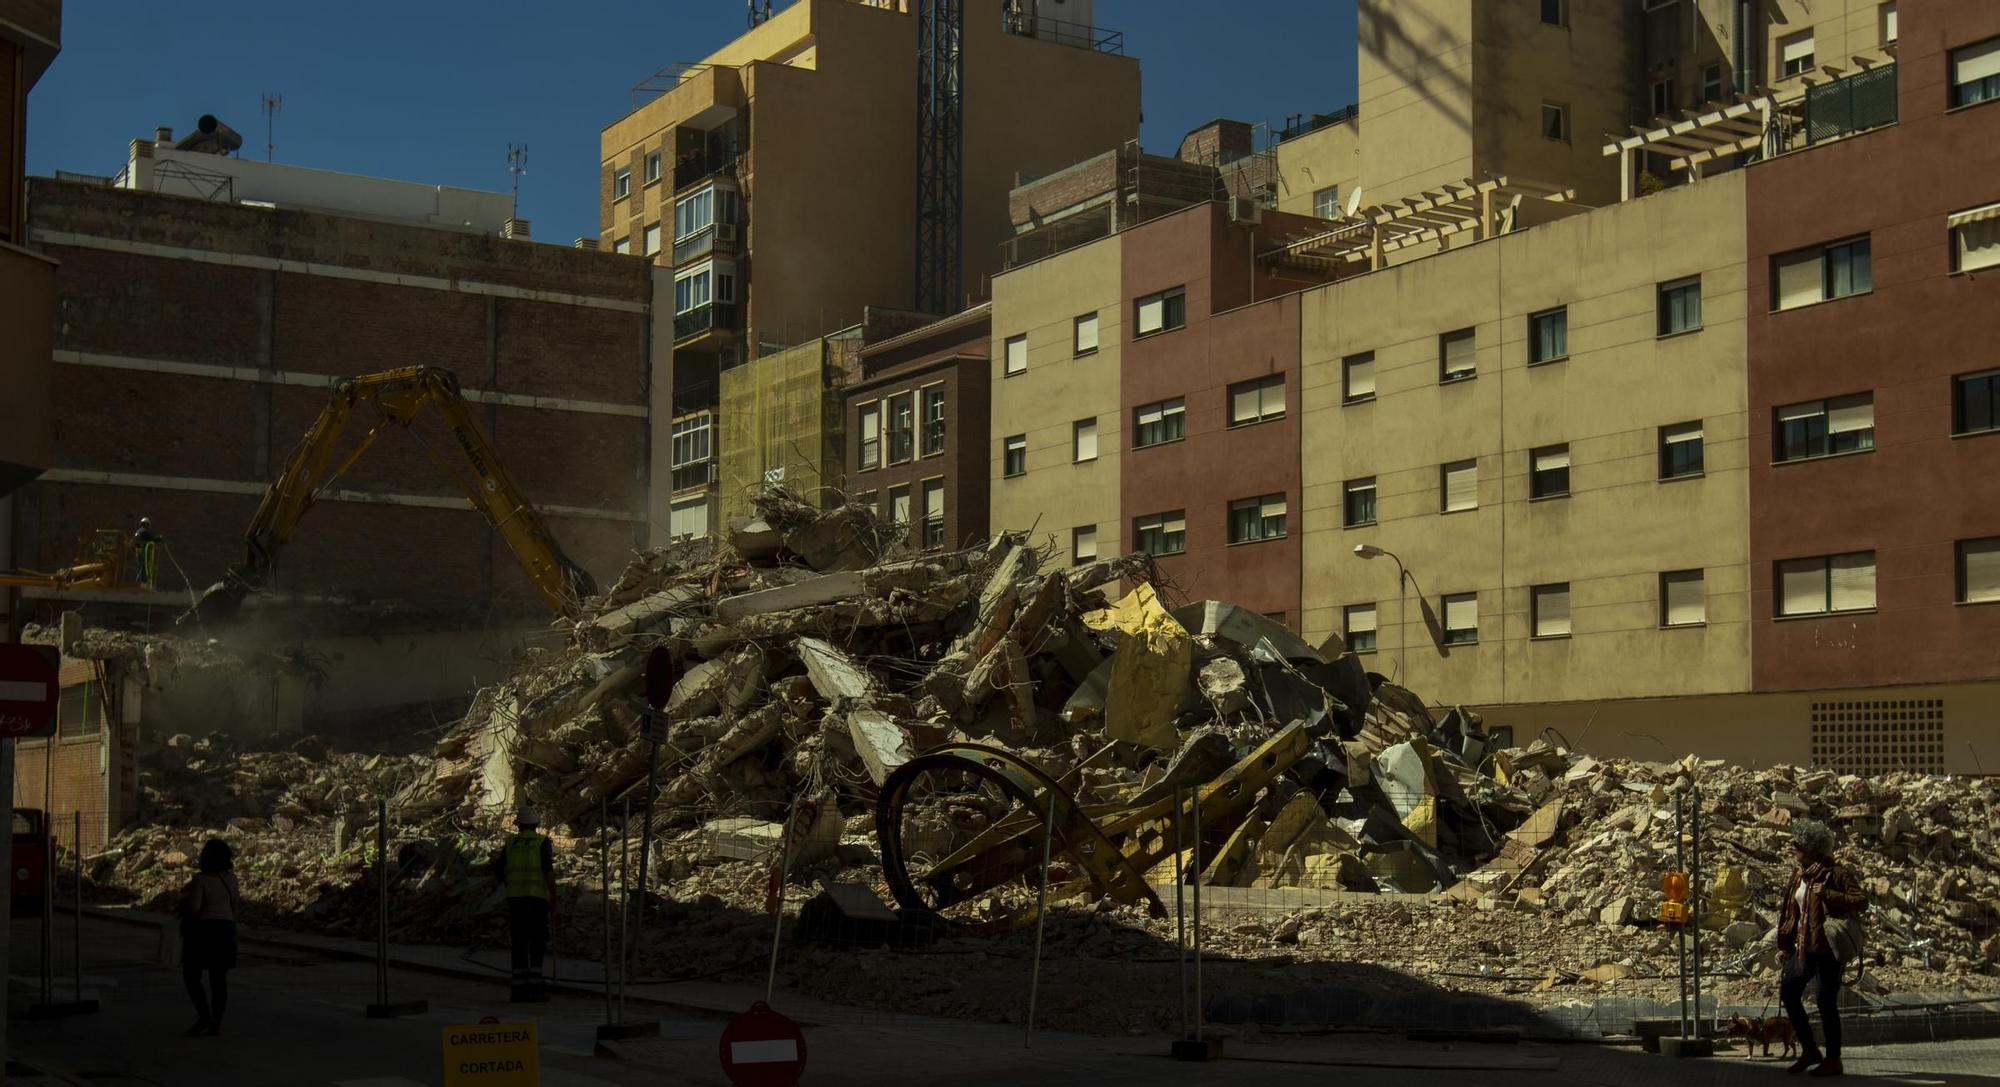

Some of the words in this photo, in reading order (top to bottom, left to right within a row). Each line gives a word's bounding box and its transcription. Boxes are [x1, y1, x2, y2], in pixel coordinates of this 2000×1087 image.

[454, 426, 487, 477] KOMATSU
[450, 1030, 530, 1046] CARRETERA
[460, 1060, 524, 1074] CORTADA
